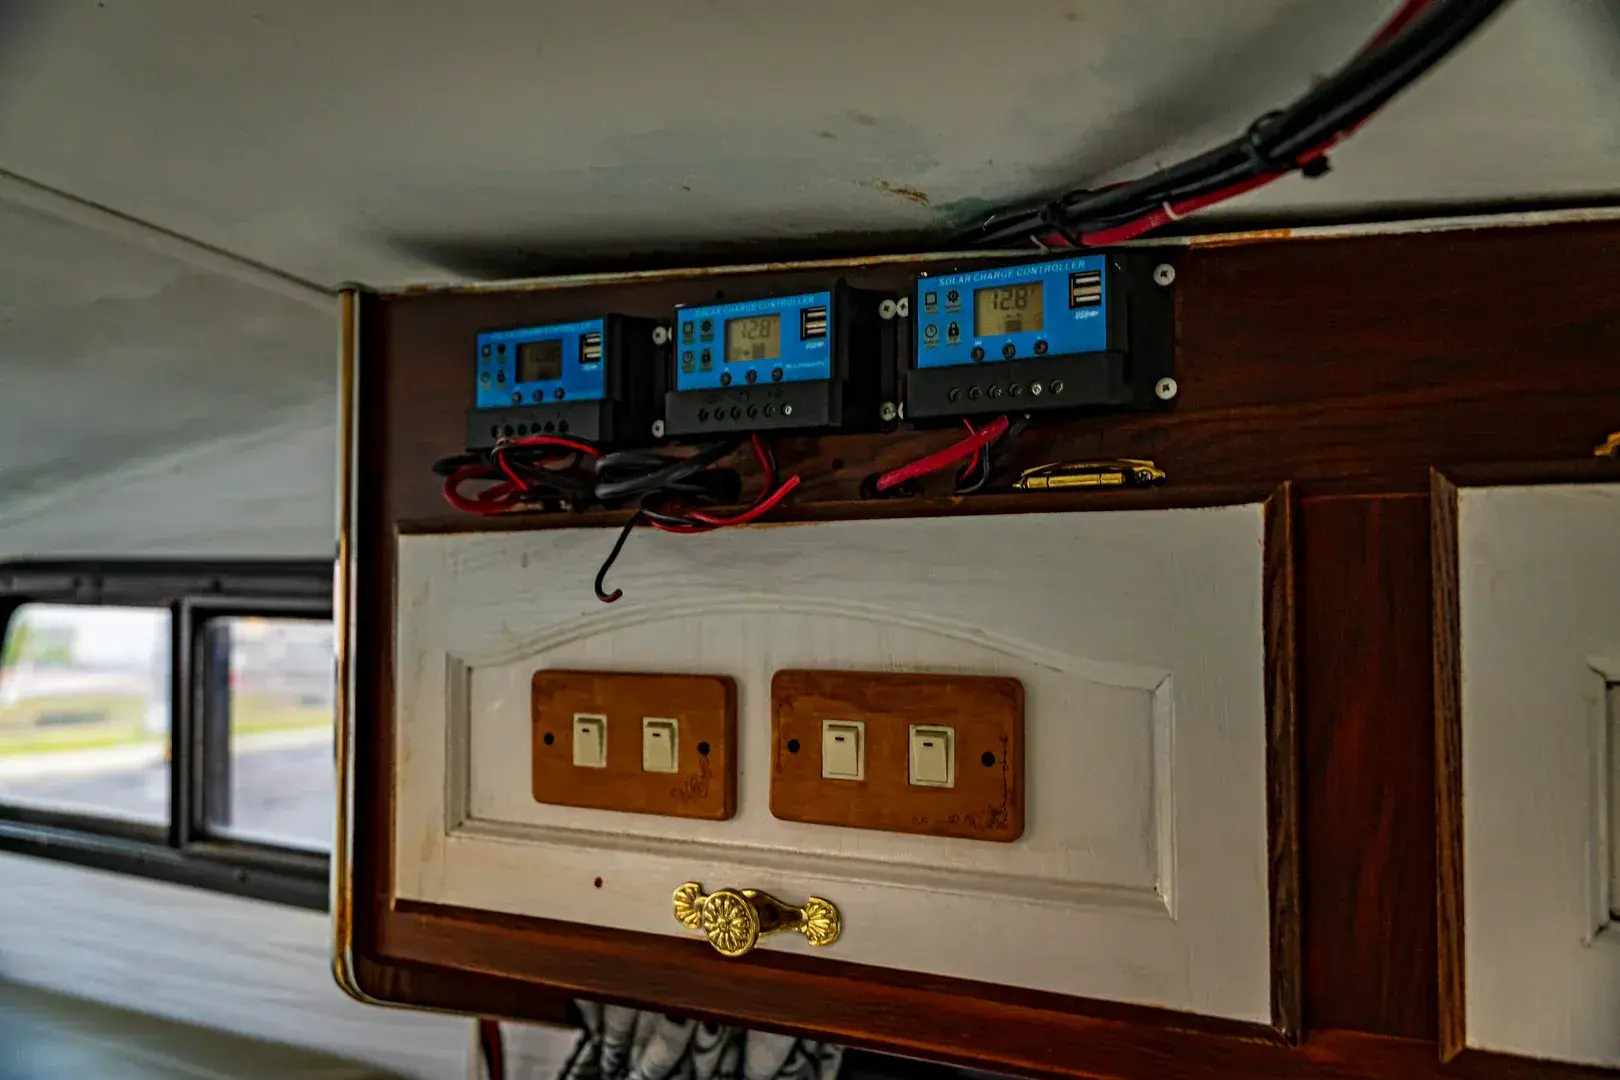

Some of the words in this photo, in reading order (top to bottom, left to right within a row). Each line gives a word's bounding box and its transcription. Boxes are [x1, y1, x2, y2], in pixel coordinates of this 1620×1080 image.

[938, 276, 972, 287] SOLAR
[973, 270, 1015, 283] CHARGE
[1017, 260, 1086, 277] CONTROLLER
[758, 295, 815, 310] CONTROLLER
